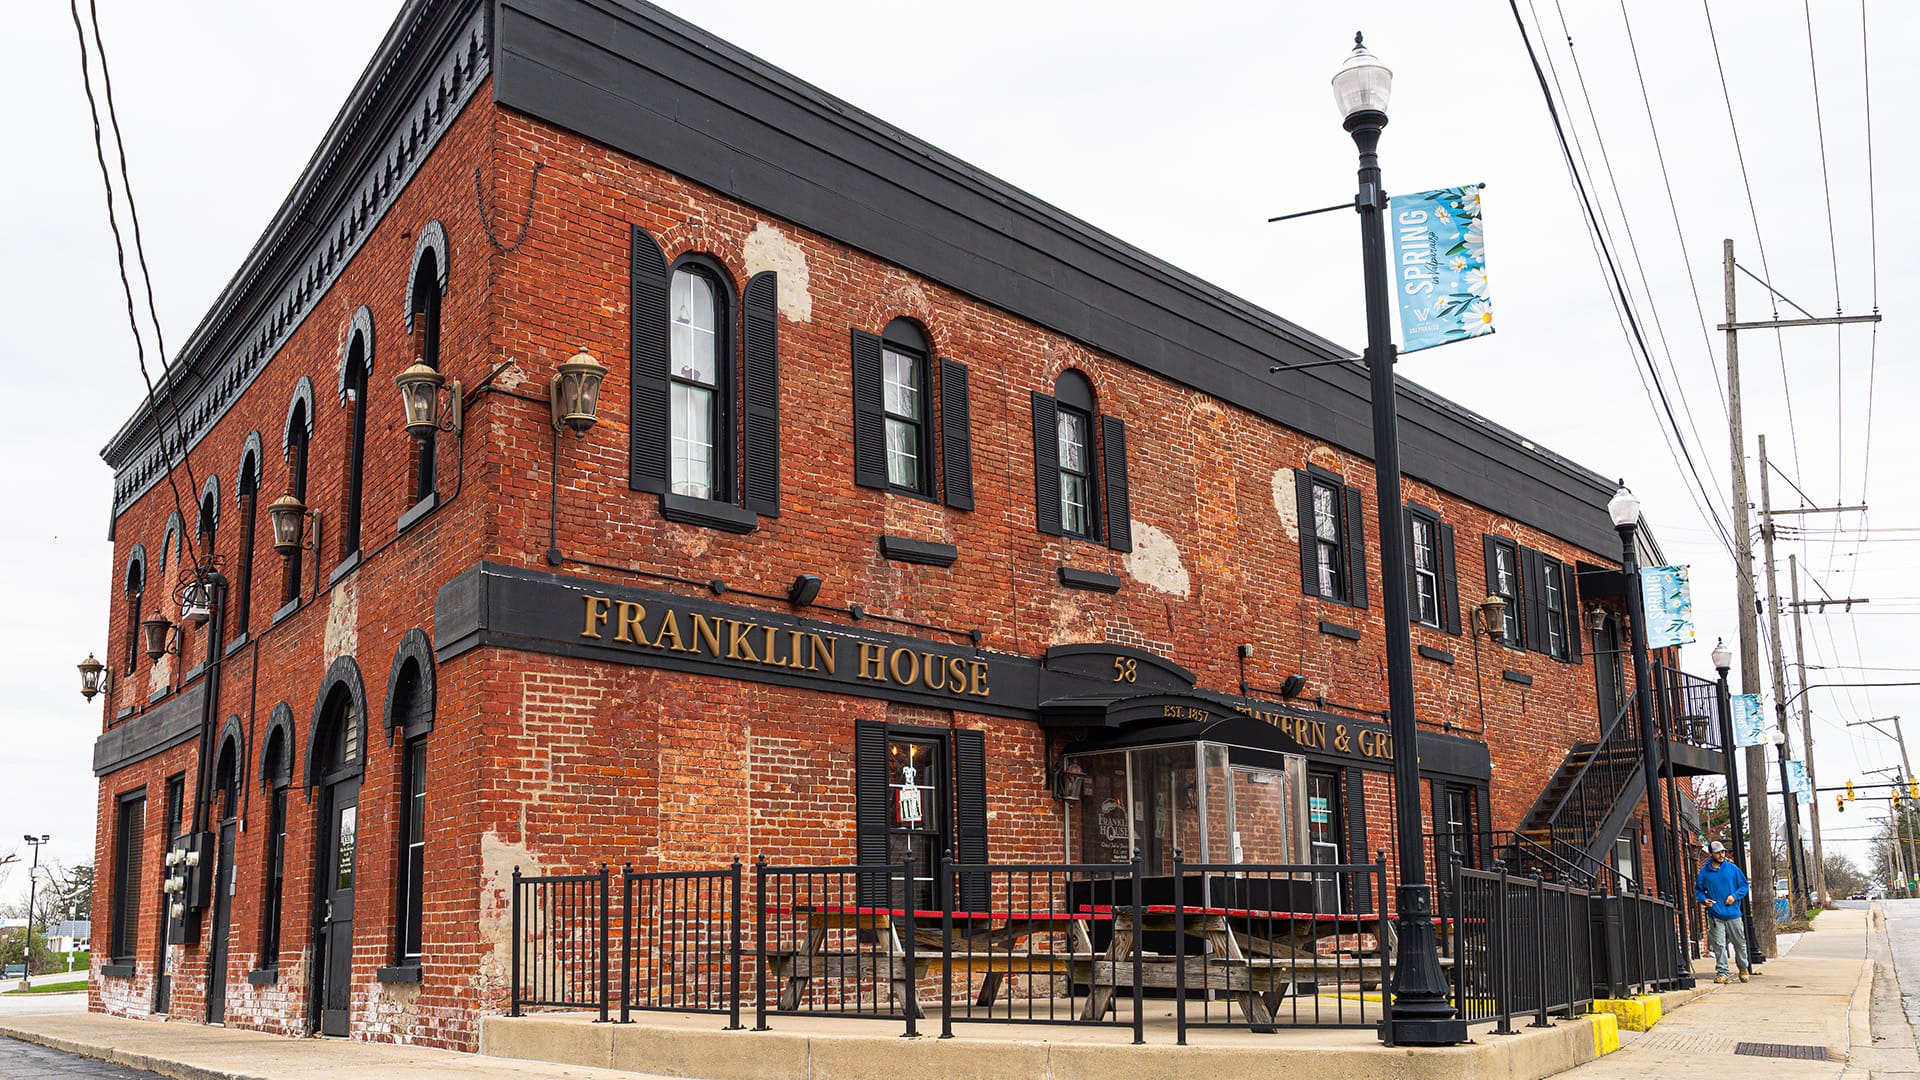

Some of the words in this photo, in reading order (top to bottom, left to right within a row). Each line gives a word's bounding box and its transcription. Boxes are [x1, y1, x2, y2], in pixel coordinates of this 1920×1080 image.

[1399, 209, 1434, 299] SPRING
[1646, 575, 1665, 620] SPRING
[580, 594, 837, 674] FRANKLIN
[856, 641, 990, 697] HOUSE
[1112, 656, 1138, 684] 58
[1163, 704, 1185, 719] EST.
[1188, 707, 1210, 723] 1857
[1333, 724, 1352, 754] &
[1098, 813, 1129, 827] FRANKLI
